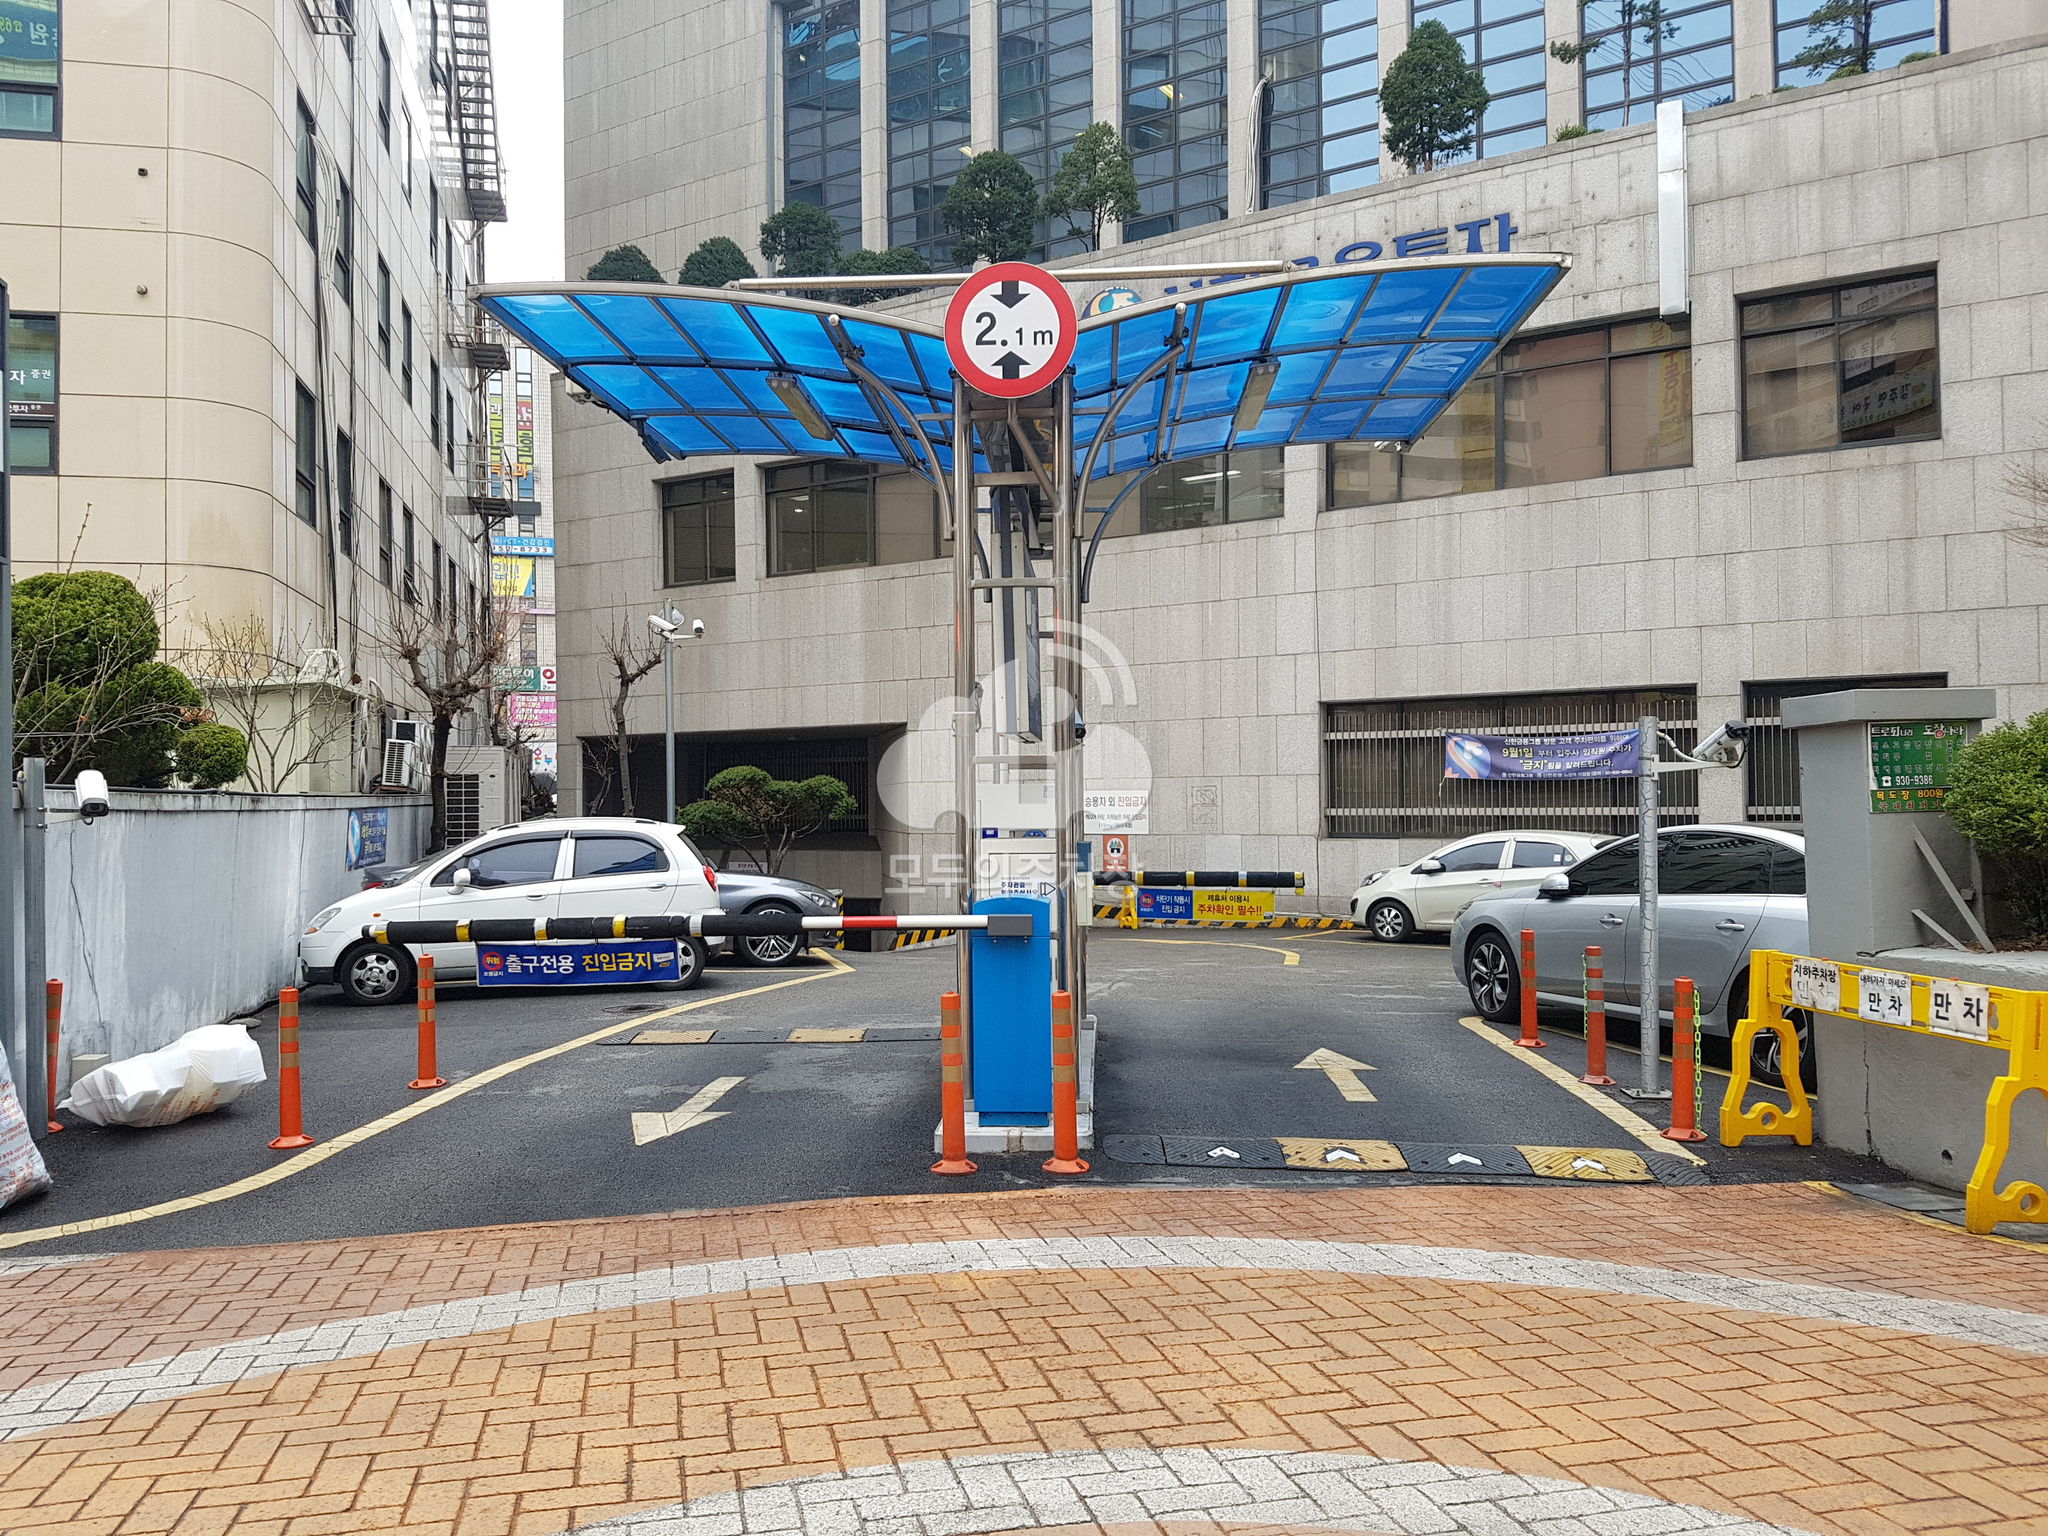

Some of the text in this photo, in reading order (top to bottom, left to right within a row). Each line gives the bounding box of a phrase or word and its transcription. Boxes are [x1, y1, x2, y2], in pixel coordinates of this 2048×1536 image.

[31, 369, 51, 379] 증권
[1922, 722, 1964, 739] 도장나라
[1504, 737, 1541, 746] 신한금융그룹
[1559, 737, 1572, 745] 고객
[1574, 735, 1607, 744] 주차편의를
[1502, 747, 1534, 758] 9월1일
[1538, 749, 1553, 758] 부터
[1556, 748, 1579, 758] 입주사
[1583, 747, 1606, 757] 임직원
[1896, 774, 1934, 786] 930-9386
[1917, 788, 1944, 799] 800원
[1085, 796, 1147, 808] 승용차 외 진입금지
[1155, 895, 1191, 904] 차단기 작동시
[1230, 895, 1250, 903] 이용시
[1161, 905, 1185, 914] 진입 금지
[1197, 904, 1234, 915] 주차확인
[1238, 905, 1262, 916] 필수!!
[505, 954, 575, 974] 출구전용
[582, 952, 652, 972] 진입금지
[1793, 964, 1836, 984] 지하주차장
[1860, 974, 1907, 989] 내려가지 마세요
